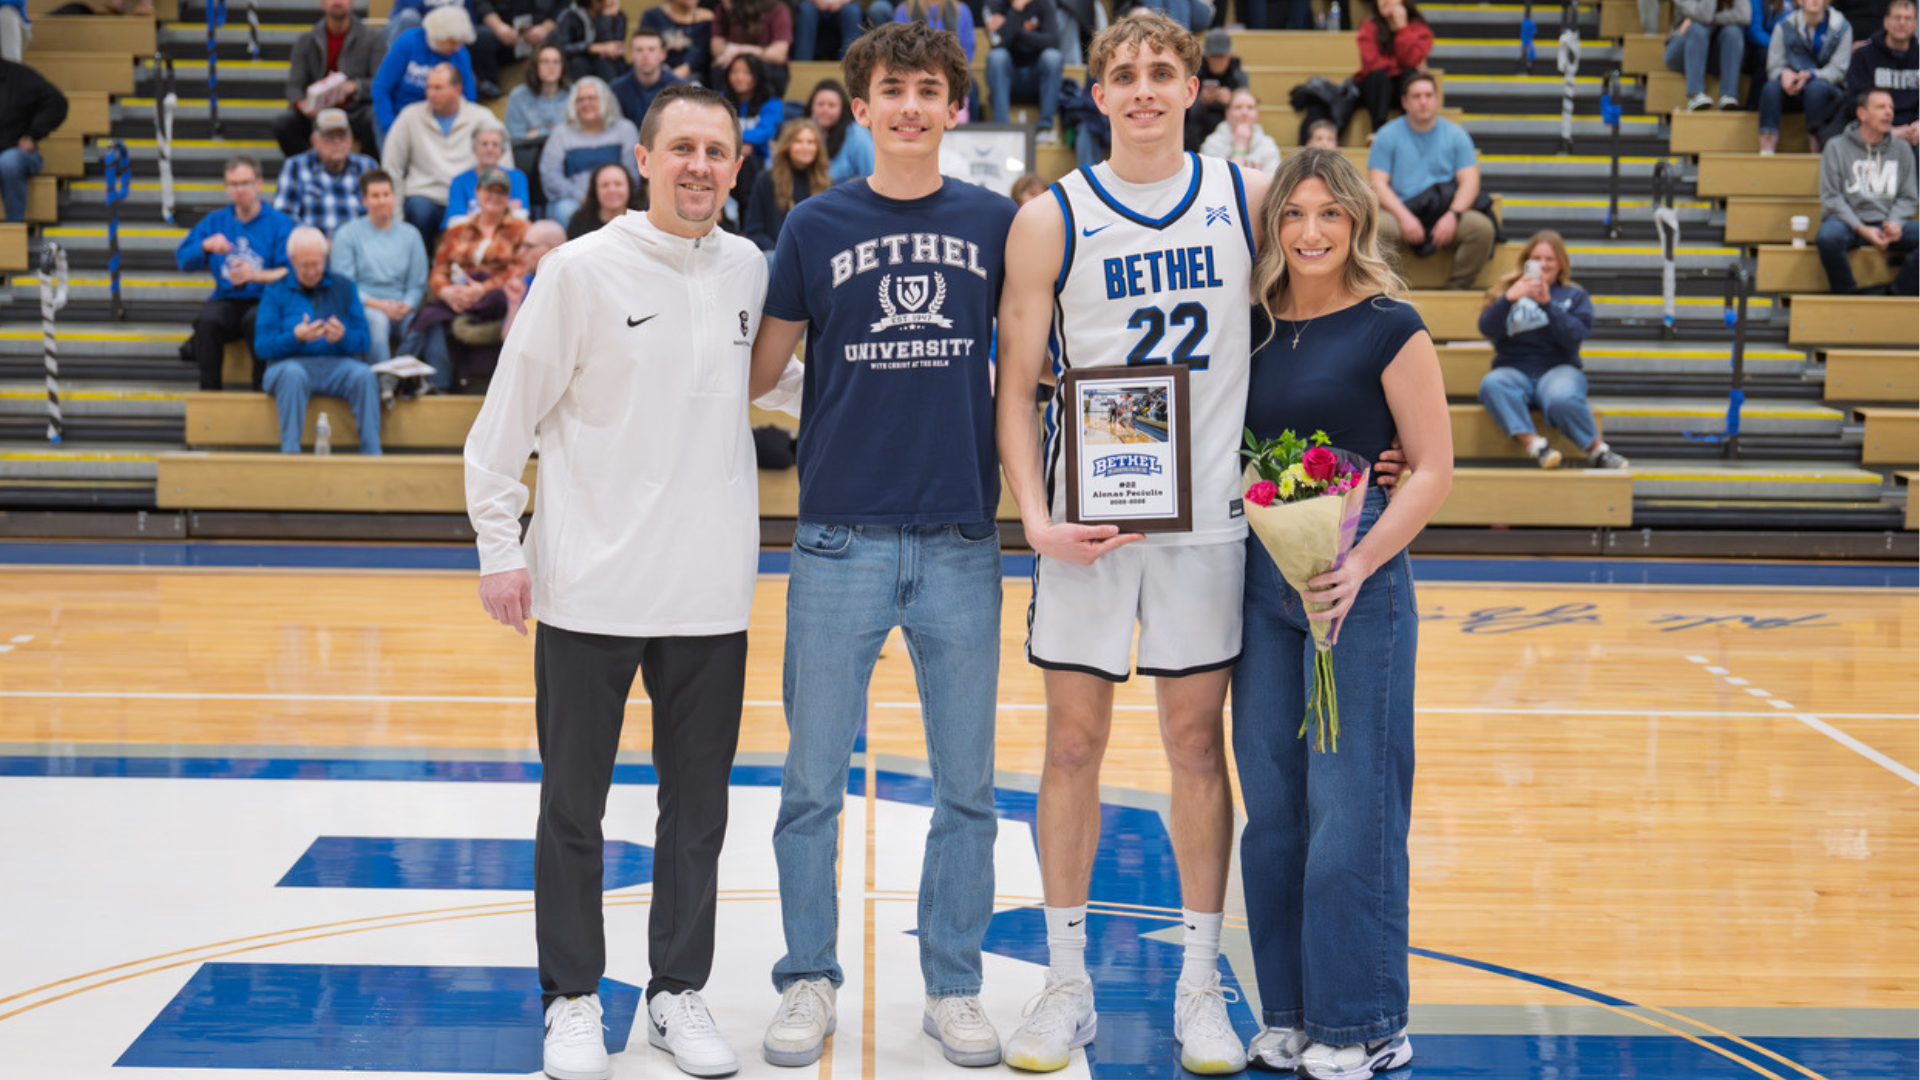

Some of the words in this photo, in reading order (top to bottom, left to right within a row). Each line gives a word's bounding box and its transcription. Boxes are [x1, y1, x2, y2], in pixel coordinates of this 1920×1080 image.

[830, 233, 987, 289] BETHEL
[1103, 245, 1223, 300] BETHEL
[1126, 301, 1210, 371] 22
[844, 338, 975, 362] UNIVERSITY
[870, 362, 887, 370] WITH
[888, 361, 910, 369] CHRIST
[932, 359, 949, 367] HELM
[1093, 454, 1162, 475] BETHEL
[1119, 481, 1136, 489] #22
